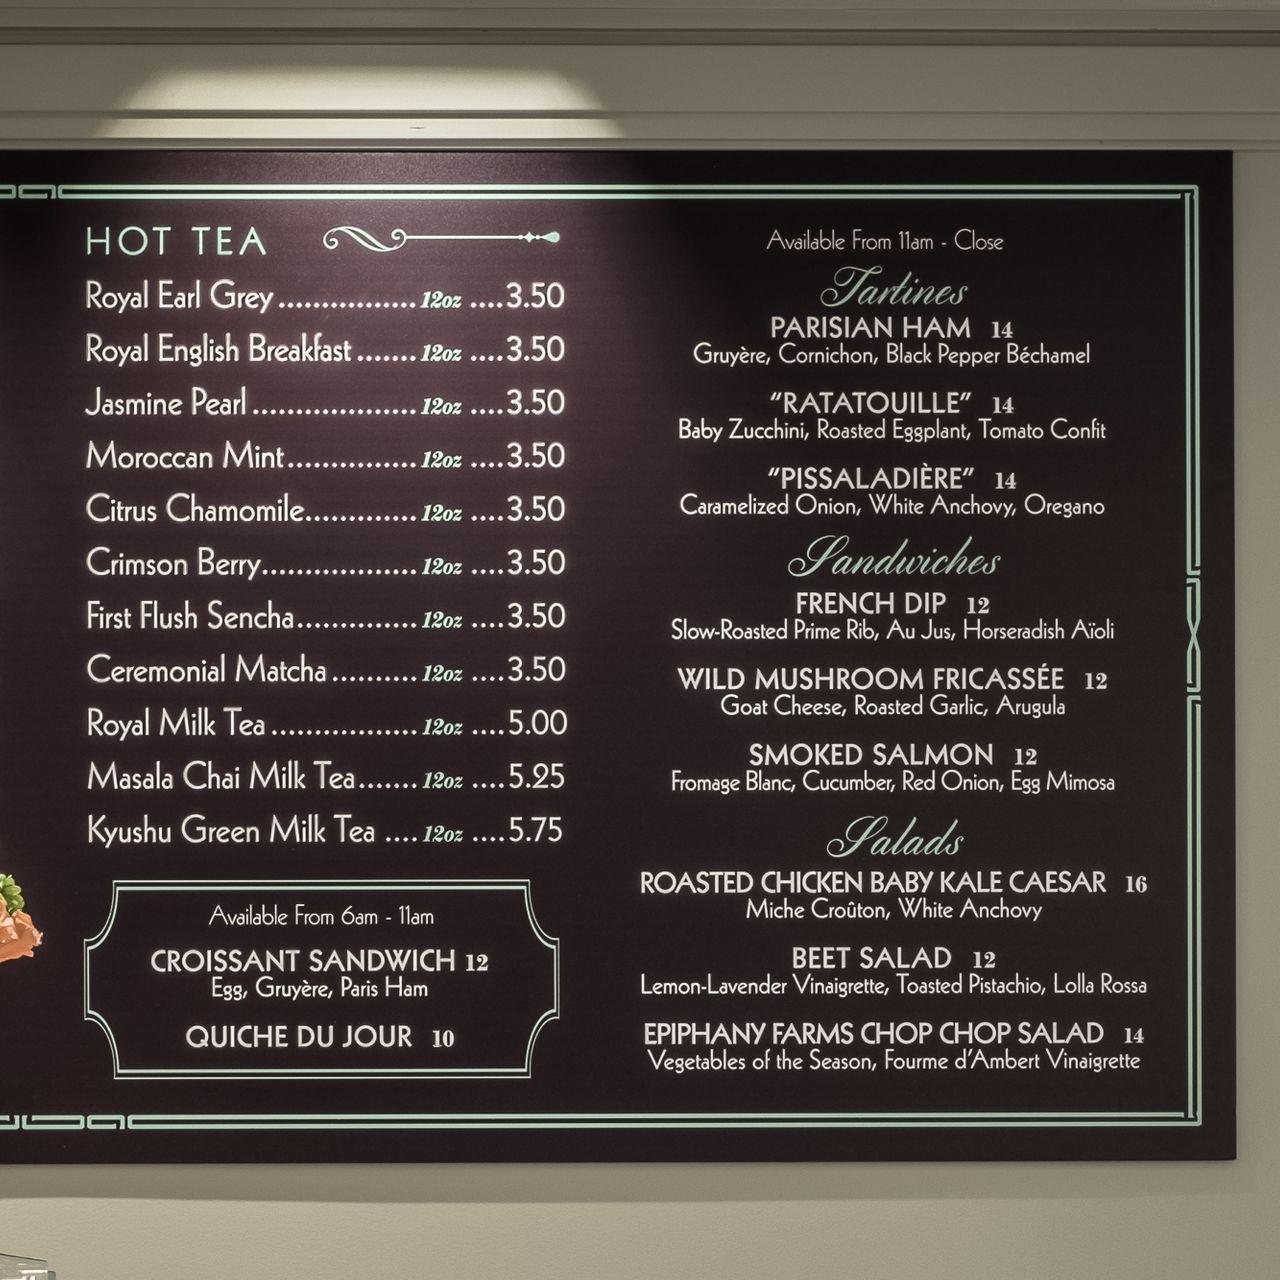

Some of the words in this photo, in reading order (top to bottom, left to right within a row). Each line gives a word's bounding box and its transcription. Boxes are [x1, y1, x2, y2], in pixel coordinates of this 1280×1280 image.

[87, 226, 172, 256] HOT
[191, 226, 267, 256] TEA
[766, 228, 846, 251] Available
[852, 228, 892, 251] From
[898, 230, 934, 251] 11am
[954, 228, 1004, 251] Close
[820, 265, 969, 308] Tartines
[86, 332, 149, 368] Royal
[158, 332, 240, 368] English
[248, 331, 353, 363] Breakfast
[420, 343, 462, 362] 12oz
[506, 335, 565, 362] 3.50
[992, 396, 1015, 414] 14
[678, 417, 724, 443] Baby
[728, 417, 810, 441] Zucchini,
[817, 417, 886, 439] Roasted
[893, 417, 971, 443] Eggplant,
[977, 417, 1044, 439] Tomato
[1050, 417, 1107, 440] Confit
[787, 534, 1002, 578] Sandwiches
[671, 617, 788, 640] Slow-Roasted
[794, 618, 841, 640] Prime
[846, 618, 880, 641] Rib,
[886, 618, 916, 640] Au
[920, 618, 956, 641] Jus,
[963, 618, 1065, 640] Horseradish
[1070, 618, 1115, 640] Aïoli
[88, 814, 172, 849] Kyushu
[181, 813, 260, 844] Green
[269, 813, 326, 843] Milk
[333, 813, 375, 843] Tea
[422, 825, 464, 843] 12oz
[509, 816, 563, 843] 5.75
[826, 815, 965, 858] Salads
[150, 949, 301, 973] CROISSANT
[309, 948, 455, 972] SANDWICH
[465, 953, 489, 972] 12
[792, 946, 851, 969] BEET
[859, 946, 952, 970] SALAD
[973, 951, 996, 969] 12
[211, 975, 248, 1002] Egg,
[255, 975, 334, 1001] Gruyère,
[341, 975, 379, 998] Paris
[385, 975, 428, 997] Ham
[641, 972, 788, 995] Lemon-Lavender
[791, 972, 890, 998] Vinaigrette,
[895, 972, 963, 994] Toasted
[969, 972, 1046, 996] Pistachio,
[1053, 972, 1095, 994] Lolla
[1101, 972, 1147, 994] Rossa
